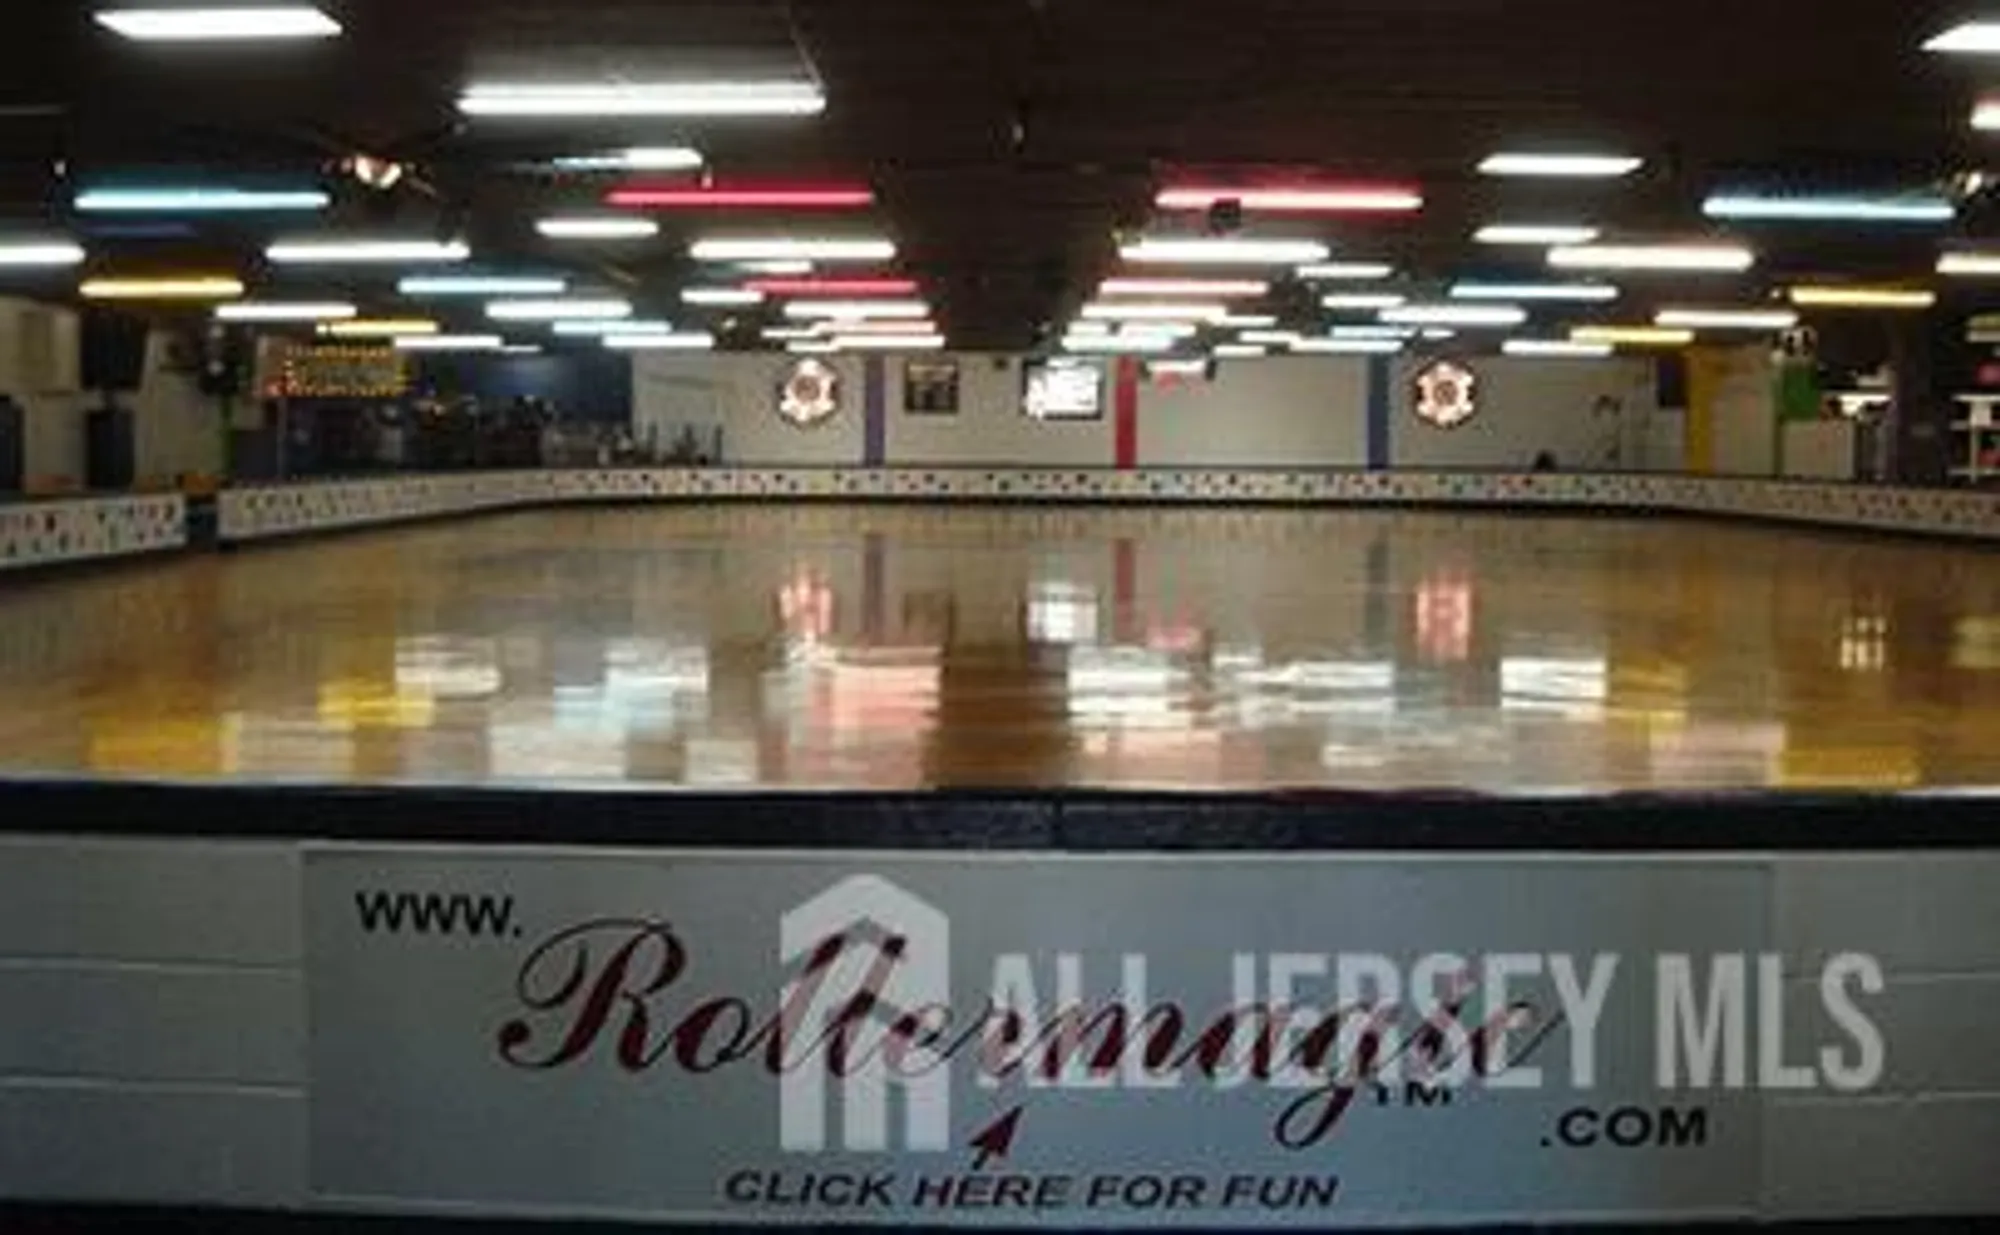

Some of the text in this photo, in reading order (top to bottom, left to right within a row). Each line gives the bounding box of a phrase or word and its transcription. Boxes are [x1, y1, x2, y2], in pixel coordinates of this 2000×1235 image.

[356, 890, 523, 939] WWW.
[1540, 1107, 1708, 1149] .COM
[725, 1170, 1338, 1209] CLICK HERE FOR FUN
